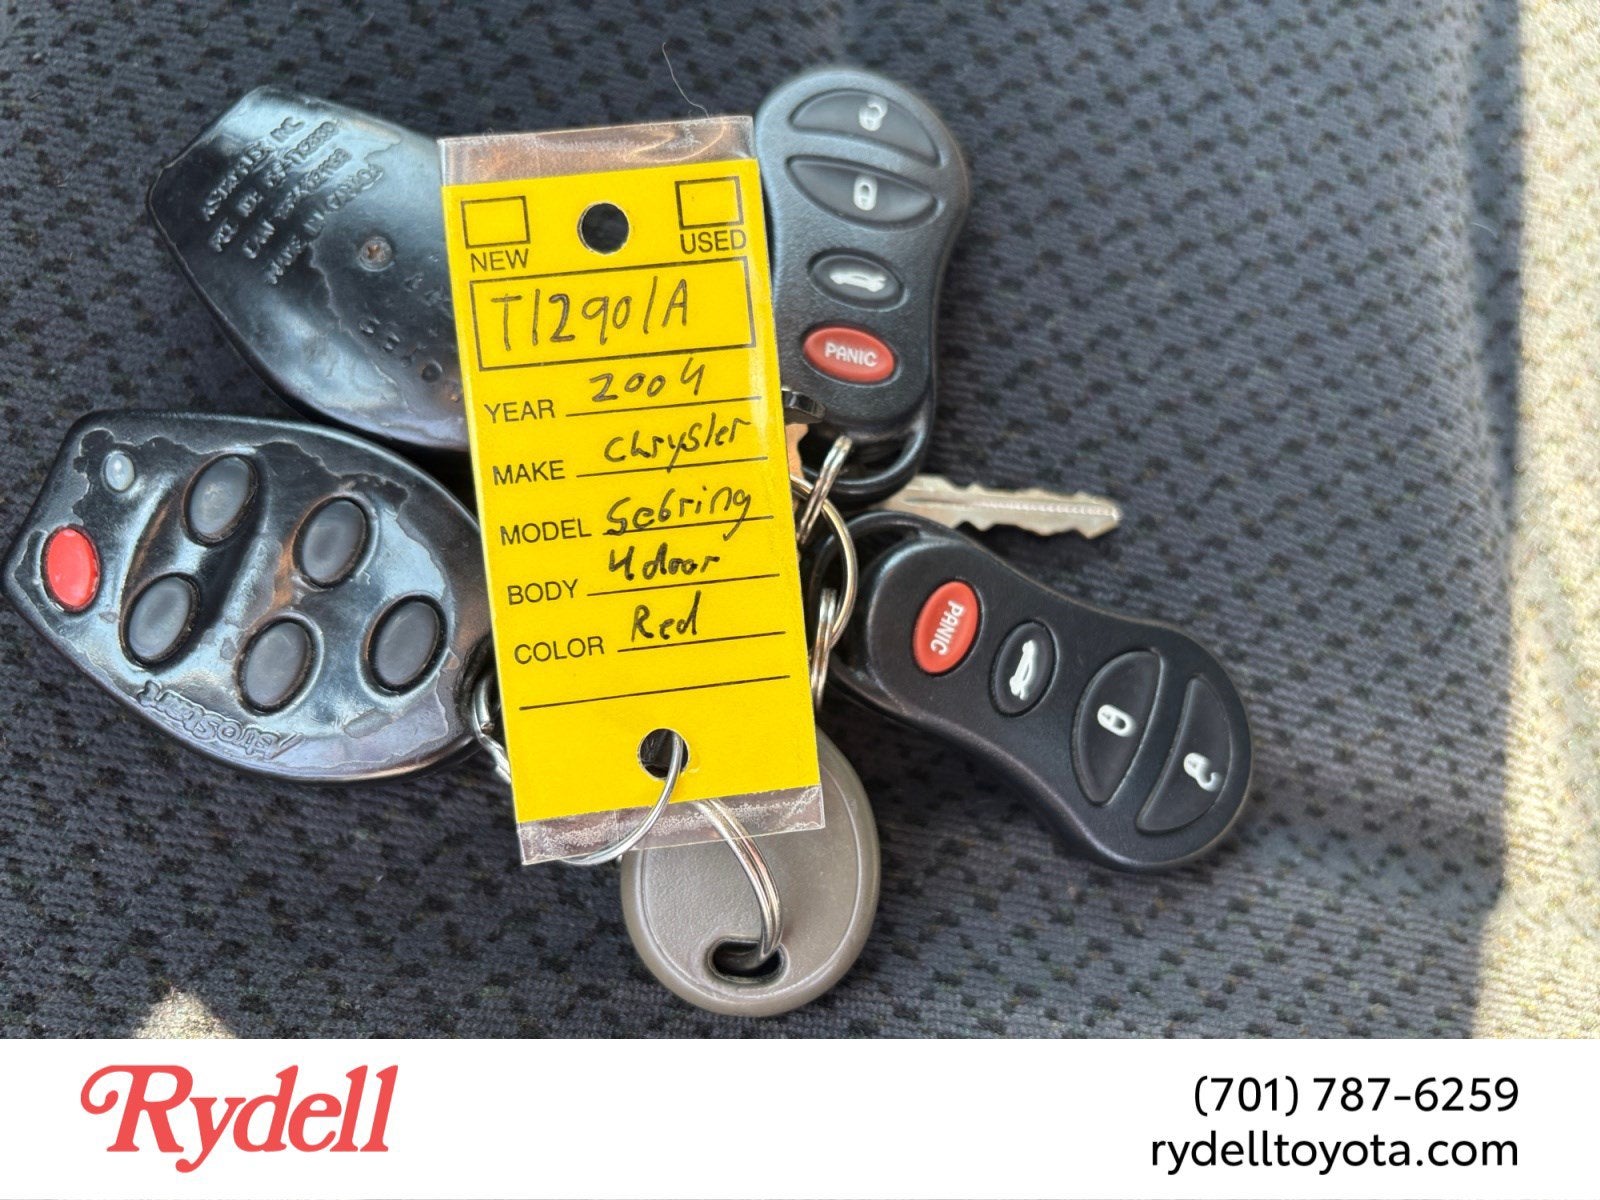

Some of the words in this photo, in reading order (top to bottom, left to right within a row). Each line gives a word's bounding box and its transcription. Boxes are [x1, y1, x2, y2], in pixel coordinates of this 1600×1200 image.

[680, 228, 747, 255] USED
[470, 248, 530, 273] NEW
[824, 341, 879, 368] PANIC
[589, 357, 705, 402] 2004
[484, 398, 556, 424] YEAR
[492, 459, 566, 486] MAKE
[500, 518, 592, 546] MODEL
[507, 578, 579, 606] BODY
[631, 590, 702, 643] Red
[930, 600, 963, 656] PANIC
[514, 635, 605, 665] COLOR
